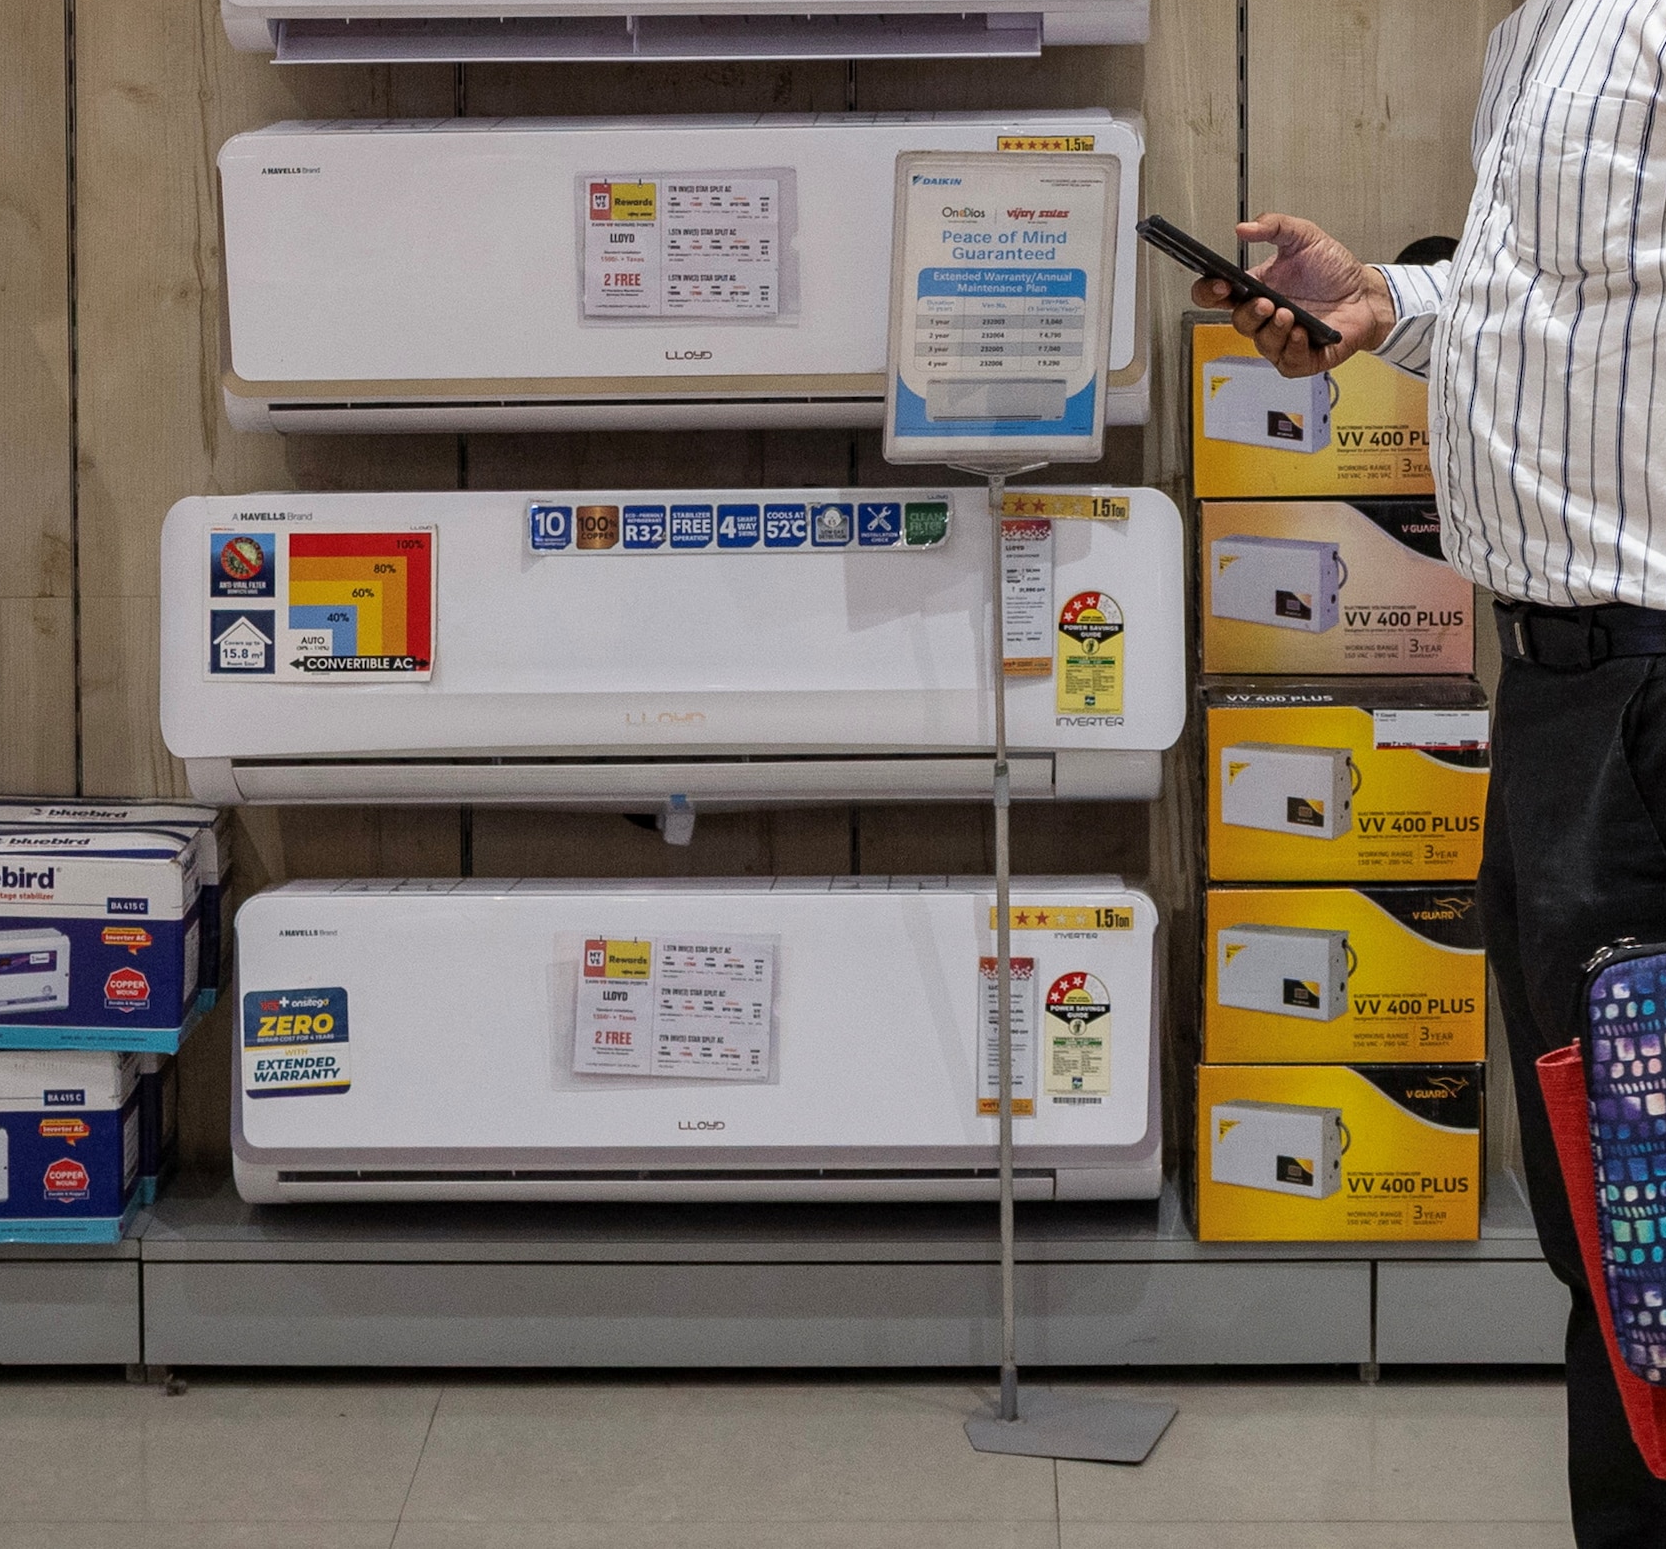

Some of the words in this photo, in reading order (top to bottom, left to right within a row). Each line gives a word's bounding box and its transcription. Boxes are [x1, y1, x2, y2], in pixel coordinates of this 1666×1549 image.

[610, 233, 634, 243] LLOYD
[942, 230, 992, 244] Peace
[998, 230, 1017, 243] of
[1023, 230, 1067, 244] Mind
[953, 247, 1056, 261] Guaranteed
[604, 274, 610, 285] 2
[615, 273, 641, 285] FREE
[933, 271, 980, 282] Extended
[983, 271, 1072, 284] Warranty/Annual
[957, 283, 1022, 293] Maintenance
[1026, 284, 1047, 293] Plan
[665, 351, 712, 359] LLOYD
[535, 512, 565, 536] 10
[672, 519, 711, 534] FREE
[626, 525, 663, 542] R32
[396, 540, 424, 549] 100%
[374, 564, 396, 574] 80%
[352, 589, 375, 599] 60%
[327, 613, 350, 623] 40%
[308, 658, 391, 670] CONVERTIBLE
[394, 658, 413, 670] AC
[110, 981, 144, 989] COPPER
[1347, 1179, 1374, 1193] VV
[1381, 1179, 1415, 1192] 400
[1421, 1177, 1469, 1192] PLUS
